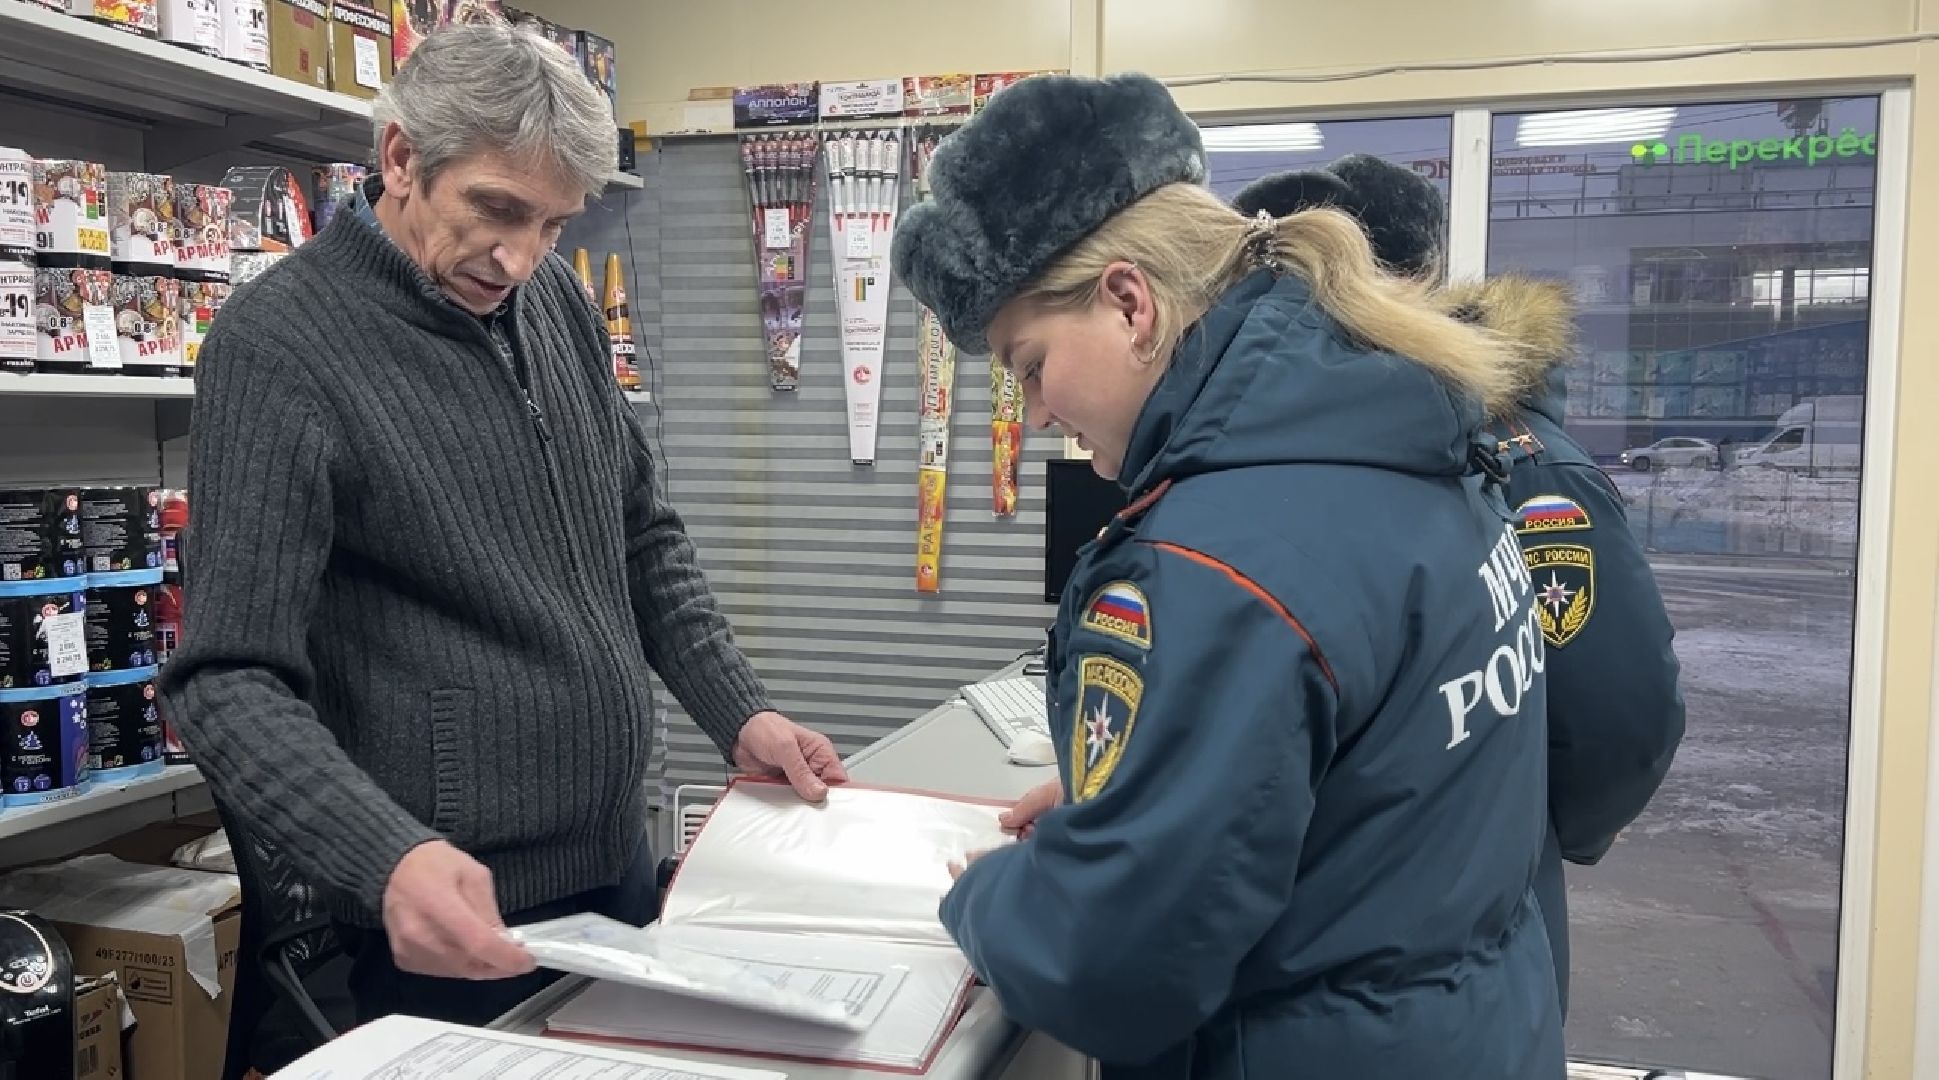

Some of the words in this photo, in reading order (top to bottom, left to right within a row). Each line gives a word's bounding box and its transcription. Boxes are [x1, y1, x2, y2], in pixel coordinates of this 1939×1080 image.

[1526, 517, 1576, 530] РОССИЯ
[1545, 549, 1589, 564] РОССИИ
[1478, 522, 1533, 633] МЧ
[1094, 611, 1139, 637] РОССИЯ
